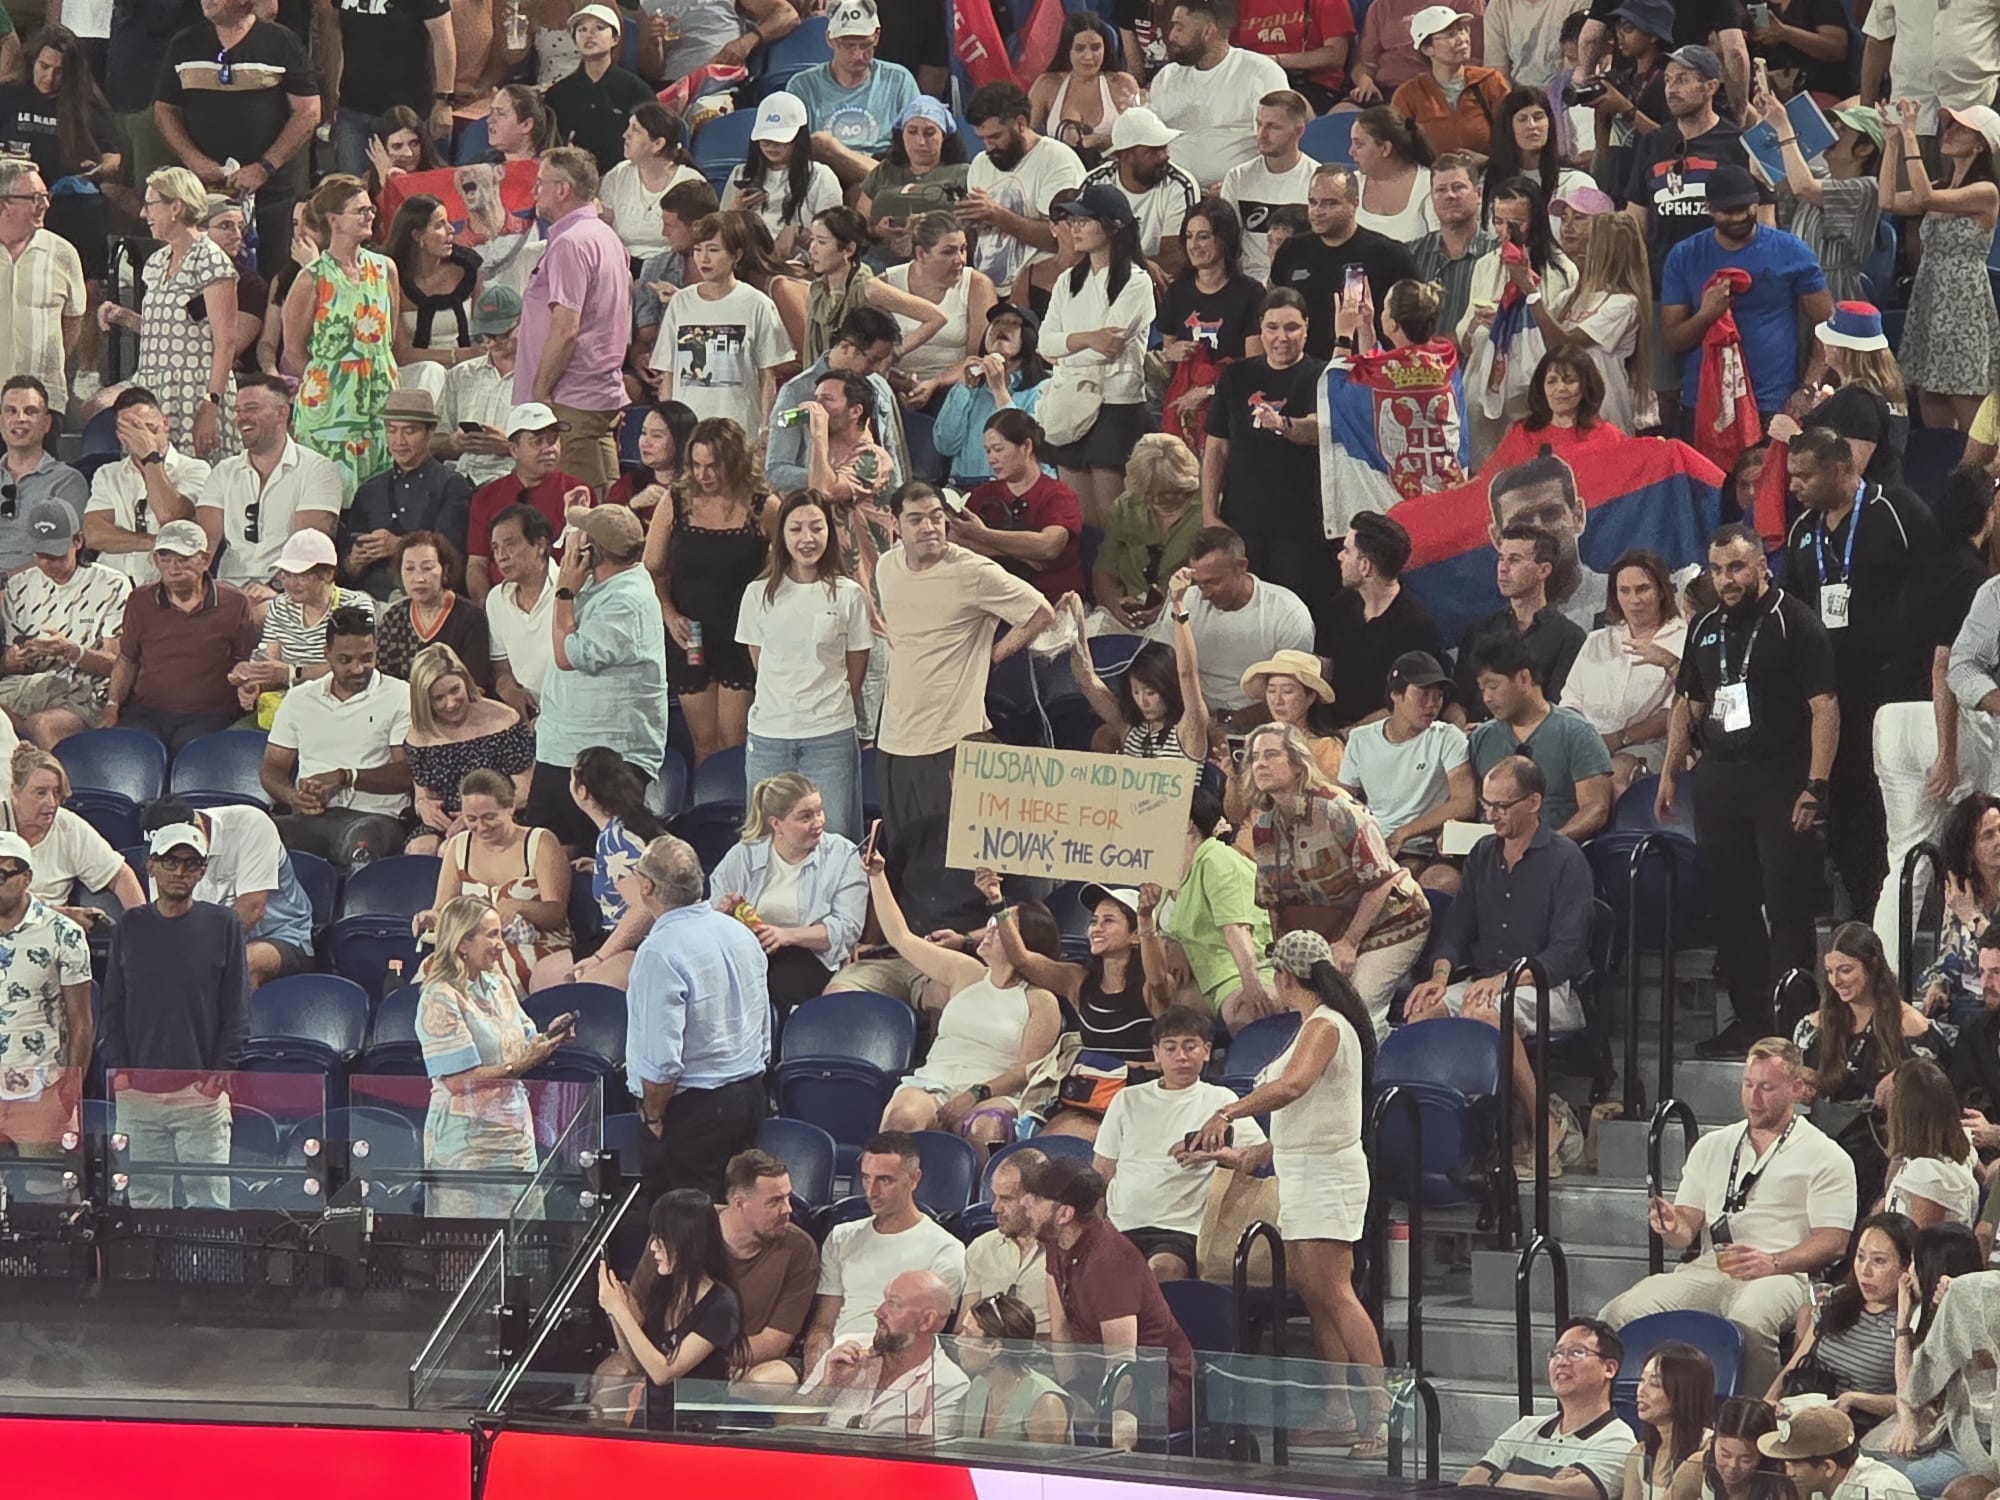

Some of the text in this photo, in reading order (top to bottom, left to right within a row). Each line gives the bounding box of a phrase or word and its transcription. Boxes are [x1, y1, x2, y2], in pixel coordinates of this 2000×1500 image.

[1699, 633, 1717, 647] AO
[963, 747, 1183, 798] HUSBAND ON KID DUTIES
[978, 792, 1010, 821] I'M
[1018, 798, 1070, 825] HERE
[1079, 806, 1123, 831] FOR
[982, 826, 1155, 870] NOVAK THE GOAT
